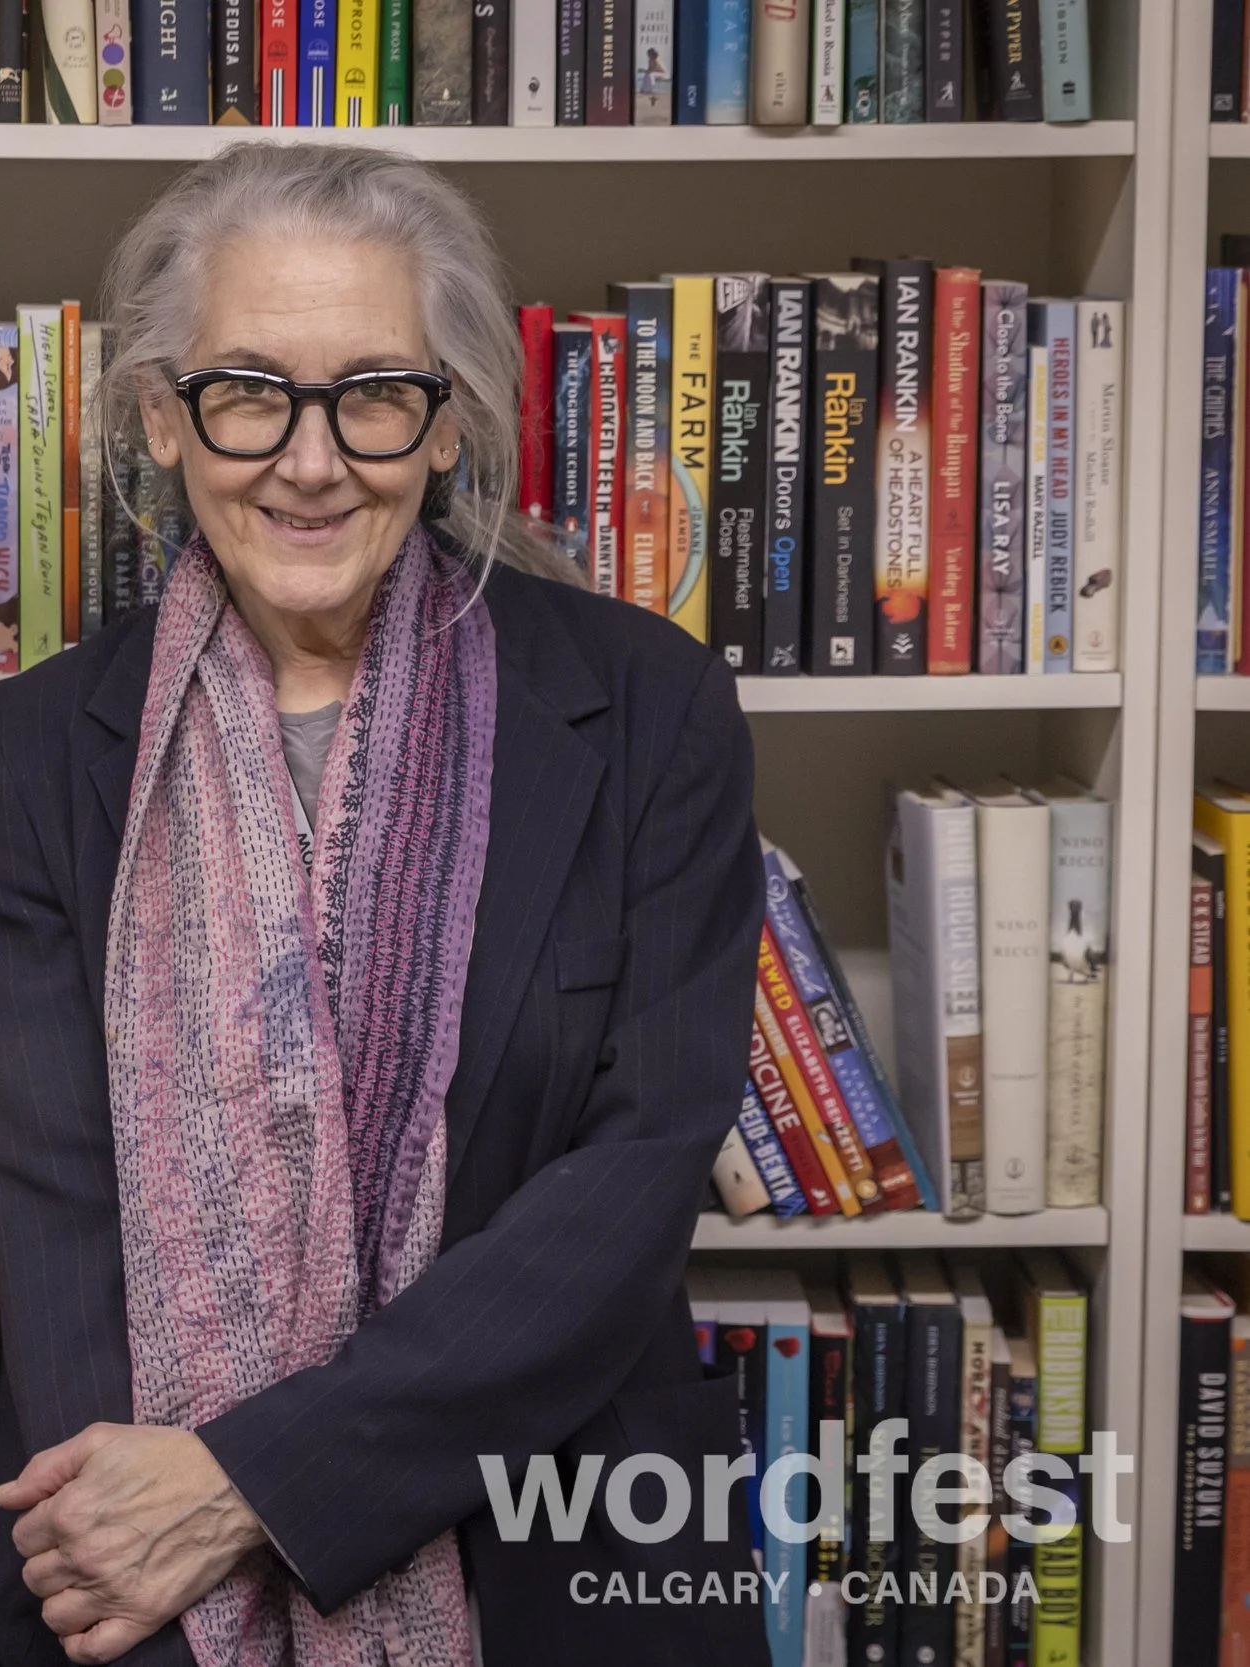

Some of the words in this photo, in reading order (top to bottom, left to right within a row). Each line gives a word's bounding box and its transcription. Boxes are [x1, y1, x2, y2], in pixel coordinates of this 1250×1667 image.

[349, 0, 363, 50] PROSE
[391, 23, 400, 62] PROSE
[1007, 7, 1023, 63] PYPER
[602, 34, 613, 79] MUSCLE
[778, 291, 802, 342] IAN
[898, 276, 919, 324] IAN
[636, 318, 657, 337] TO
[690, 334, 700, 360] THE
[636, 341, 657, 368] THE
[1053, 338, 1069, 400] HEROES
[636, 371, 657, 414] MOON
[775, 349, 801, 461] RANKIN
[896, 331, 918, 432] RANKIN
[599, 362, 617, 450] CROOKED
[681, 373, 706, 468] FARM
[743, 403, 760, 429] Ian
[824, 373, 855, 484] Rankin
[850, 398, 866, 425] Ian
[1052, 407, 1068, 421] IN
[635, 418, 656, 448] AND
[722, 380, 750, 481] Rankin
[889, 438, 904, 463] OF
[1052, 425, 1068, 449] MY
[635, 451, 655, 491] BACK
[909, 450, 923, 464] A
[1051, 453, 1068, 500] HEAD
[597, 459, 612, 513] TEETH
[775, 467, 796, 529] Doors
[908, 467, 923, 528] HEART
[994, 481, 1010, 529] LISA
[89, 464, 98, 560] BREAKWATER
[677, 509, 686, 553] RAMOS
[693, 507, 703, 556] JOANNE
[719, 509, 735, 557] Close
[838, 507, 852, 529] Set
[887, 467, 904, 589] HEADSTONES
[1051, 510, 1068, 550] JUDY
[737, 509, 754, 609] Fleshmarket
[769, 538, 795, 591] Open
[840, 534, 850, 548] in
[907, 533, 922, 577] FULL
[993, 532, 1009, 575] RAY
[837, 551, 851, 622] Darkness
[1050, 557, 1067, 613] REBICK
[298, 834, 313, 877] MO
[1059, 856, 1105, 868] RICCI
[1061, 837, 1104, 848] NINO
[786, 1015, 831, 1095] ELIZABETH
[822, 1097, 864, 1173] RENZETTI
[1042, 1332, 1084, 1447] ROBINSON
[1197, 1373, 1226, 1437] DAVID
[1196, 1447, 1224, 1527] SUZUKI
[1040, 1588, 1079, 1629] BOY
